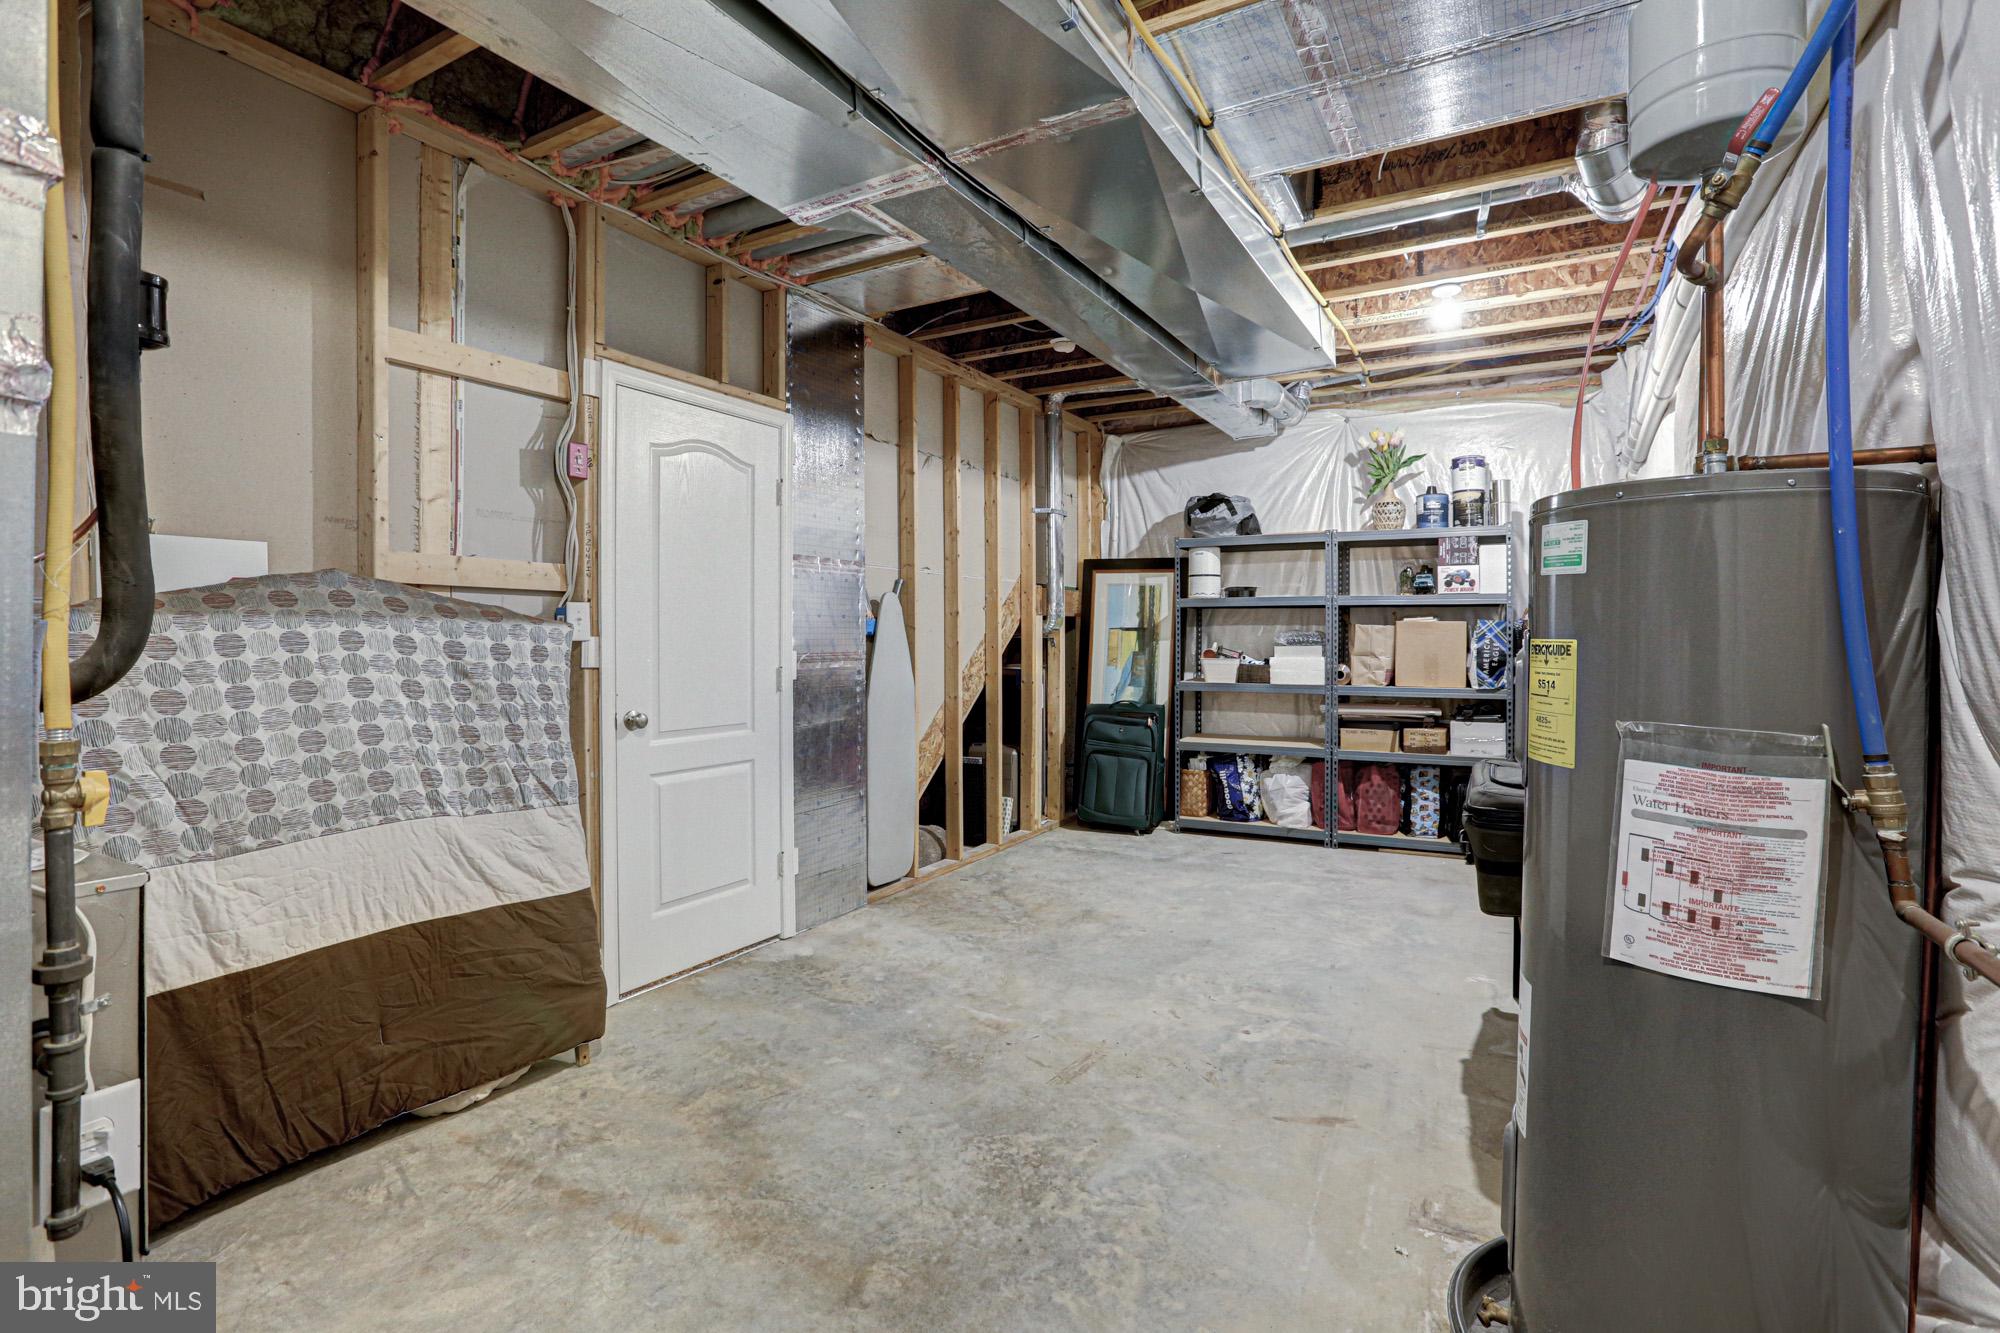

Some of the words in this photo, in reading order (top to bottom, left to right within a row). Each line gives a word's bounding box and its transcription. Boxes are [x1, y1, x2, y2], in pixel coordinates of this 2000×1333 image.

[1482, 632, 1491, 675] AMERICAN
[1491, 642, 1500, 666] EAGLE
[1537, 678, 1556, 691] $514
[1701, 762, 1747, 773] IMPORTANT
[1632, 794, 1669, 811] Water
[1675, 801, 1729, 820] Heaters
[1696, 827, 1743, 839] IMPORTANT
[1688, 897, 1740, 912] IMPORTANTE
